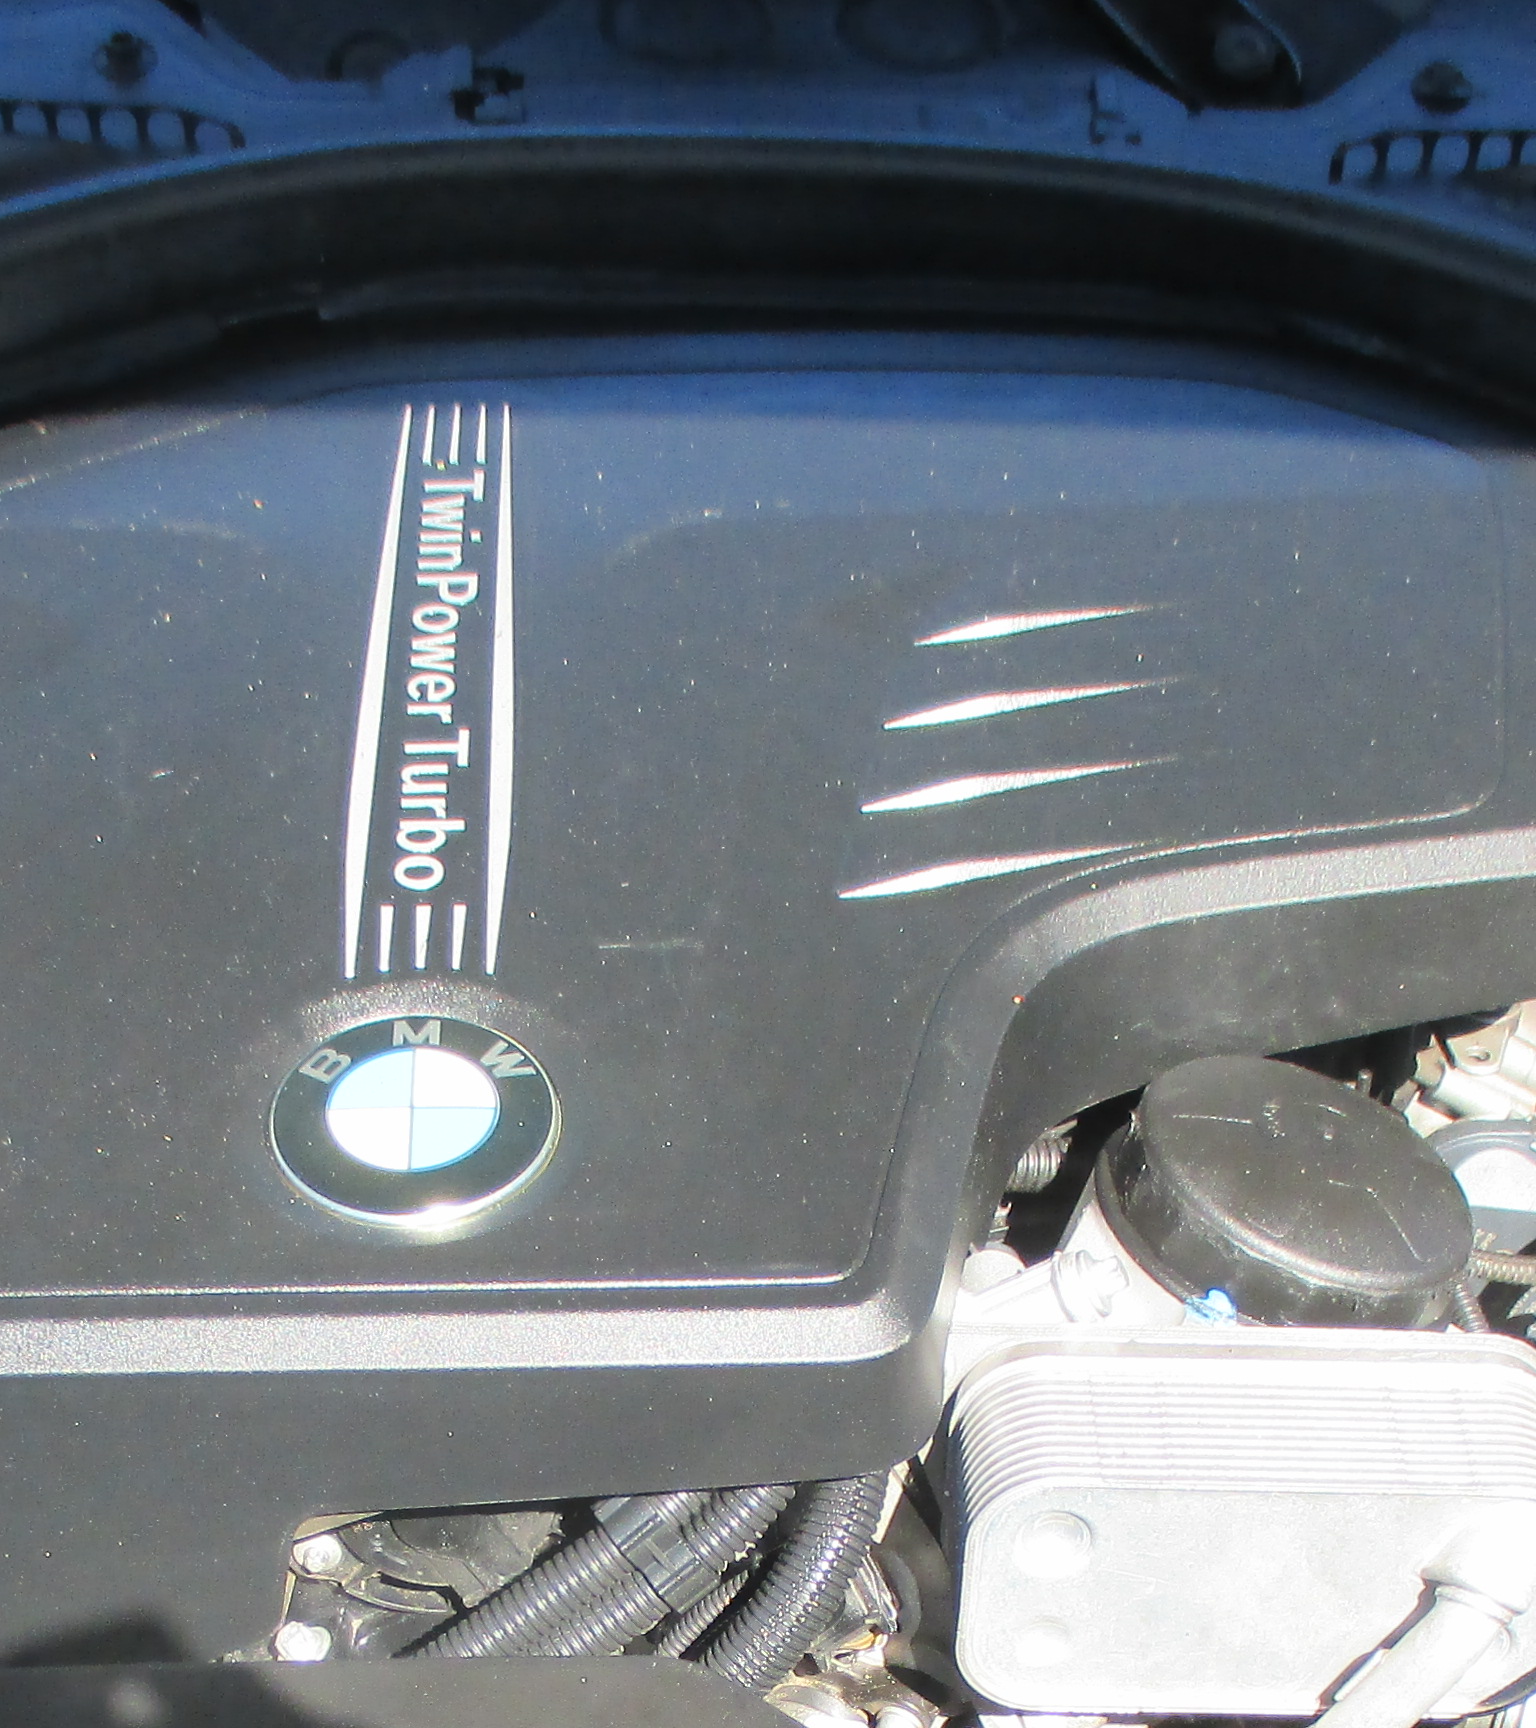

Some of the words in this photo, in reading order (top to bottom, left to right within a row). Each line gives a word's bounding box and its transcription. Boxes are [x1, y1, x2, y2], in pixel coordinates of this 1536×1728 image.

[405, 468, 485, 725] TwinPower
[393, 726, 471, 892] Turbo
[298, 1019, 537, 1085] BMW
